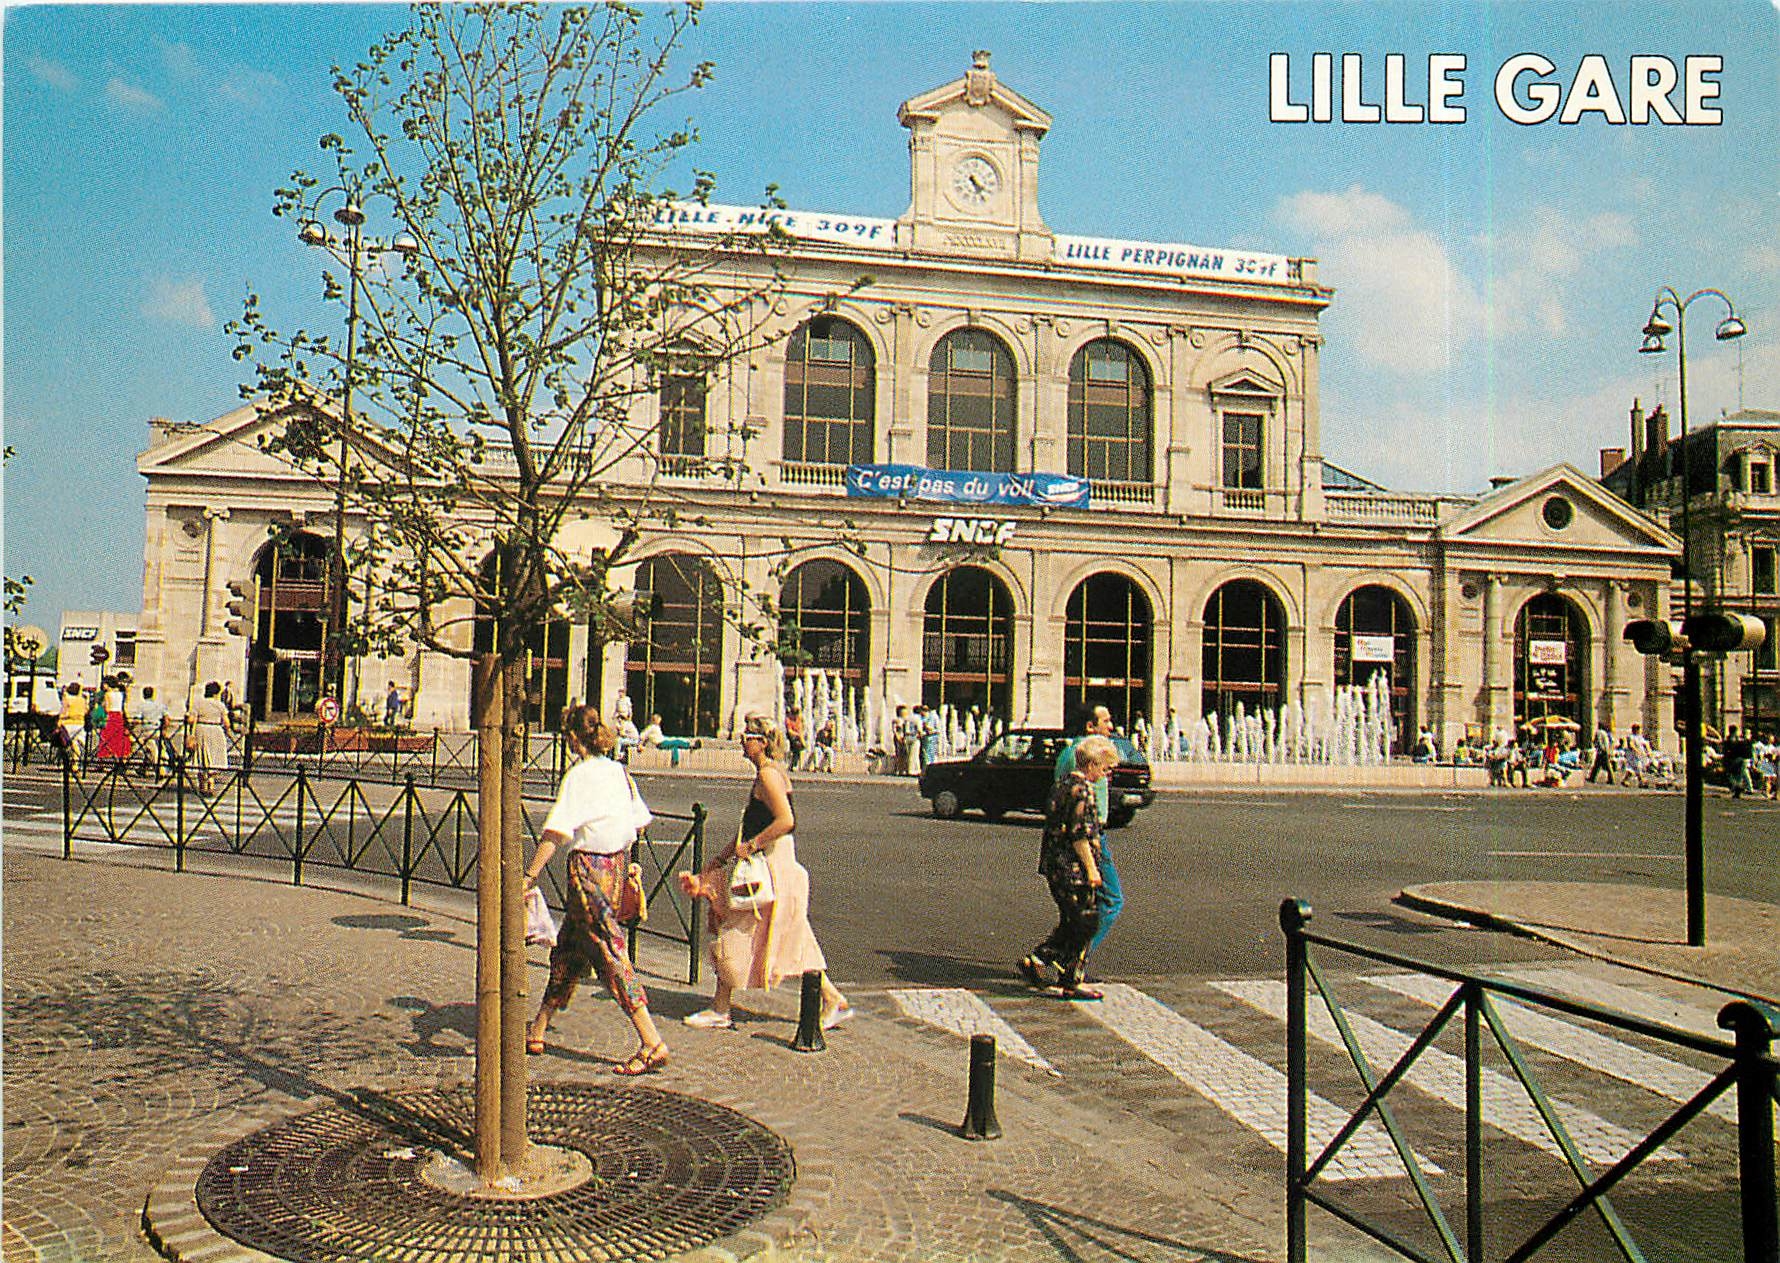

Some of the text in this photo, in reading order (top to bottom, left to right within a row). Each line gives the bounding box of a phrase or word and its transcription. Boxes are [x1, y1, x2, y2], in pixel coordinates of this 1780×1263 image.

[1066, 243, 1111, 261] LILLE
[1121, 248, 1224, 271] PERPIGNAN
[857, 470, 911, 491] C'est
[919, 478, 955, 497] pas
[963, 478, 990, 496] du
[929, 518, 1016, 545] SNCF
[63, 628, 97, 639] SNCF
